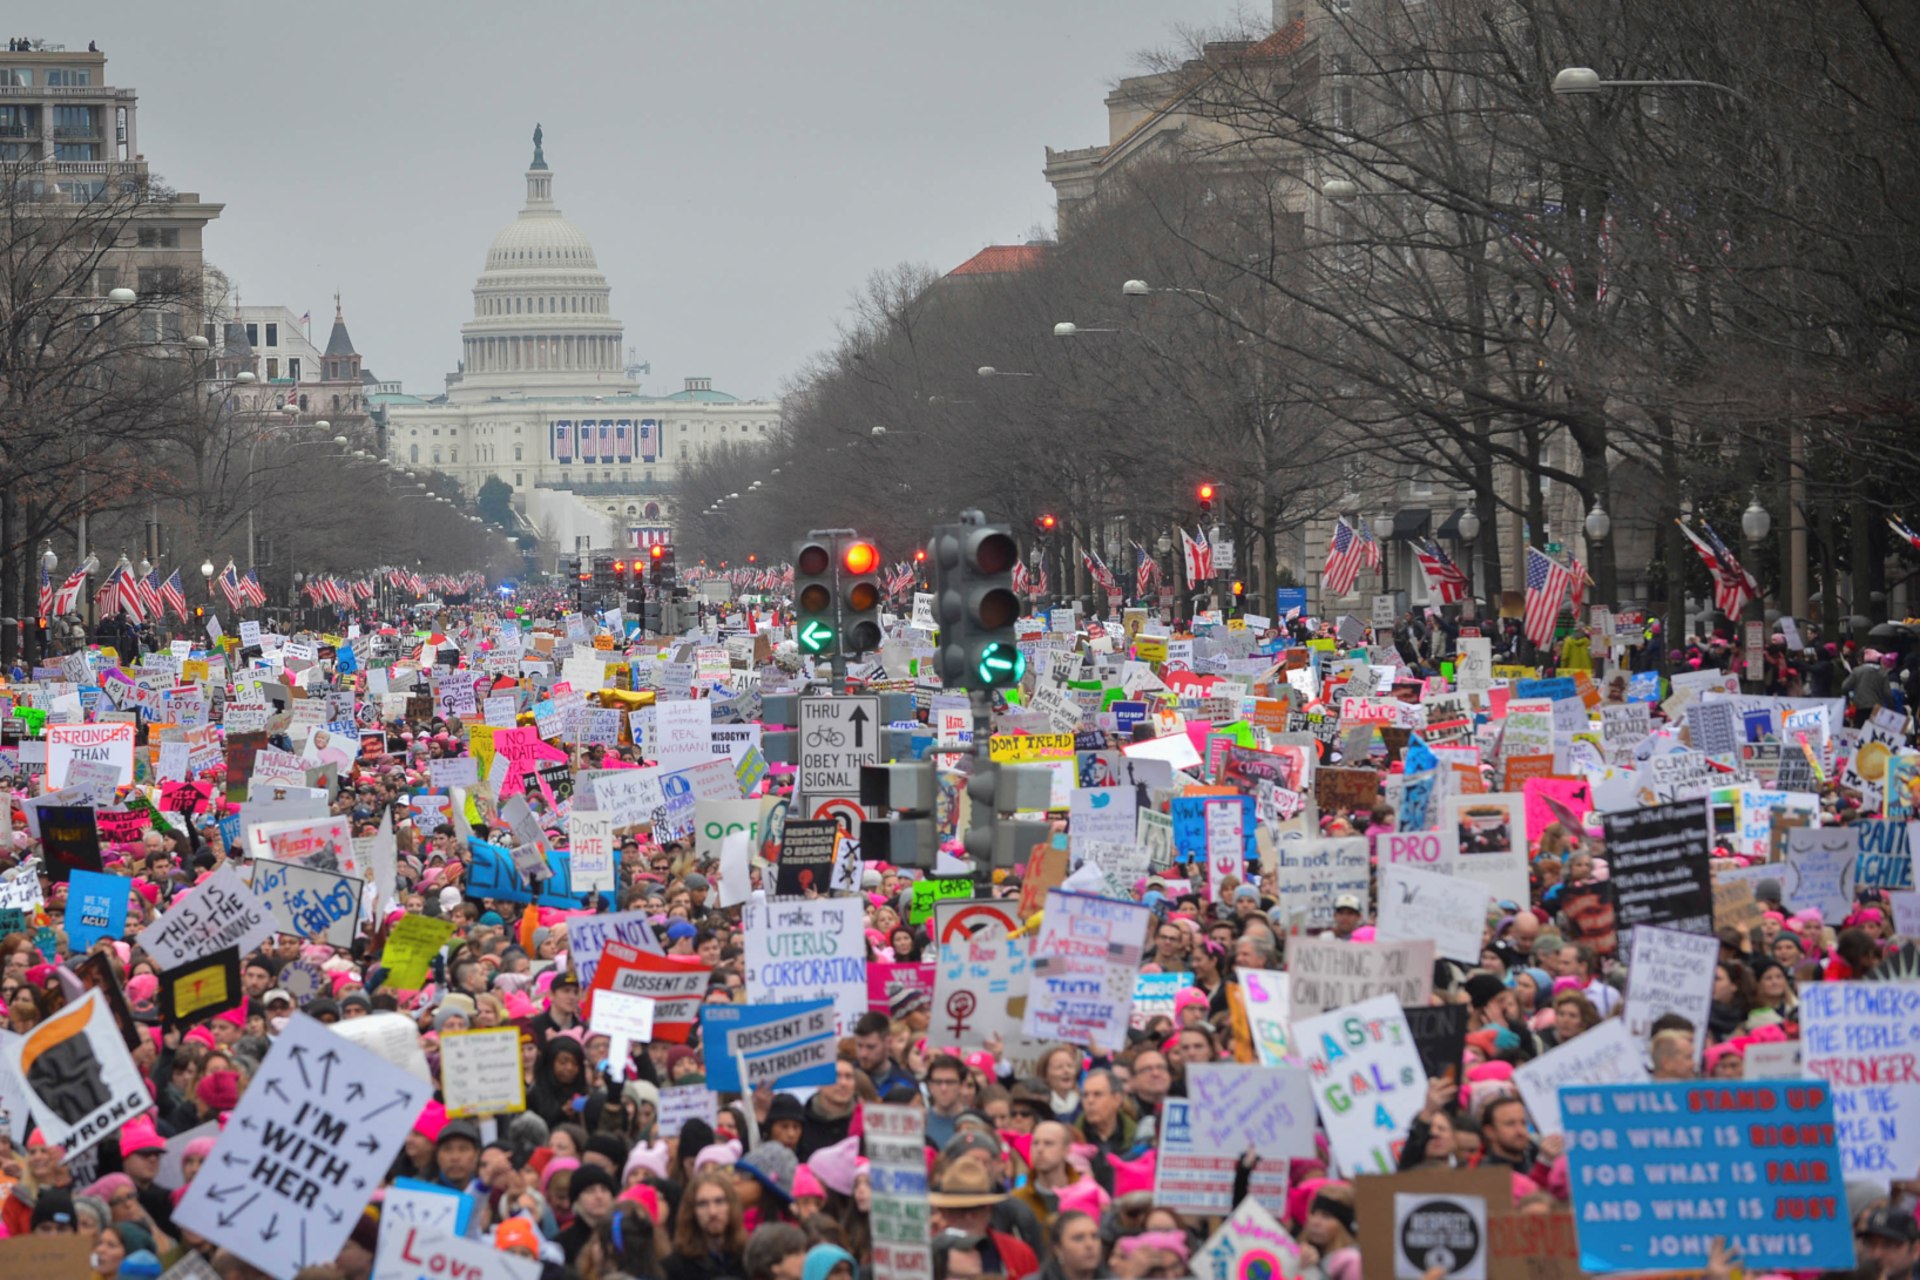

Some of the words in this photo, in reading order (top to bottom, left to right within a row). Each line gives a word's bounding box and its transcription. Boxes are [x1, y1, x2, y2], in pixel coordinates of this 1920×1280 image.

[166, 701, 201, 712] LOVE
[804, 703, 840, 719] THRU
[1344, 698, 1397, 720] future
[166, 711, 176, 724] IS
[1788, 711, 1822, 727] FUCK
[51, 728, 130, 744] STRONGER
[505, 731, 526, 746] NO
[671, 729, 699, 740] REAL
[711, 731, 750, 742] MISOGYNY
[1603, 720, 1649, 741] GREATER
[497, 744, 538, 761] ANDATE
[711, 744, 731, 754] KILLS
[1024, 734, 1072, 750] TREAD
[71, 747, 110, 761] THAN
[804, 753, 840, 769] OBEY
[846, 752, 876, 768] THIS
[1654, 753, 1705, 770] CLIMATE
[524, 769, 570, 787] FENIST
[804, 771, 853, 788] SIGNAL
[172, 798, 195, 811] UP
[785, 826, 824, 837] RESPETA
[785, 837, 834, 846] EXISTENCIA
[573, 838, 603, 855] HATE
[783, 846, 793, 855] O
[794, 846, 833, 855] ESPERA
[1389, 835, 1441, 863] PRO
[782, 855, 832, 865] RESISTENCIA
[1303, 851, 1329, 868] not
[254, 866, 288, 896] NOT
[82, 904, 110, 917] PEOPLE
[84, 895, 96, 905] WE
[97, 896, 111, 906] THE
[1080, 901, 1133, 921] MARCH
[82, 916, 109, 927] ACLU
[155, 907, 199, 948] THIS
[201, 885, 226, 911] IS
[174, 920, 210, 959] ONLY
[208, 893, 244, 928] THE
[778, 906, 814, 927] make
[822, 909, 845, 935] my
[196, 910, 261, 957] EGINNING
[613, 919, 650, 946] NOT
[766, 930, 838, 957] UTERUS
[748, 968, 756, 981] a
[761, 956, 866, 988] CORPORATION
[1294, 952, 1374, 977] ANYTHING
[1378, 950, 1411, 976] YOU
[623, 973, 682, 992] DISSENT
[684, 975, 699, 990] IS
[1046, 979, 1101, 993] TRUTH
[1802, 984, 1839, 1018] THE
[1843, 986, 1905, 1018] POWER
[736, 1019, 802, 1049] DISSENT
[808, 1013, 824, 1031] IS
[1806, 1022, 1839, 1054] THE
[1844, 1023, 1907, 1051] PEOPLE
[1309, 1017, 1404, 1081] NASTY
[749, 1043, 827, 1078] PATRIOTIC
[1806, 1052, 1920, 1088] STRONGER
[1324, 1063, 1415, 1114] GALS
[1563, 1092, 1604, 1116] WE
[1612, 1091, 1679, 1114] WILL
[1686, 1087, 1778, 1113] STAND
[1785, 1086, 1826, 1111] UP
[1861, 1087, 1899, 1113] THE
[64, 1092, 144, 1150] WRONG
[294, 1101, 349, 1147] I'M
[1878, 1116, 1897, 1142] IN
[1564, 1128, 1618, 1151] FOR
[1626, 1126, 1704, 1149] WHAT
[1714, 1125, 1741, 1147] IS
[1749, 1122, 1836, 1148] RIGHT
[261, 1118, 351, 1187] WITH
[1842, 1142, 1898, 1172] OWER
[251, 1155, 322, 1211] HER
[1581, 1164, 1635, 1187] FOR
[1643, 1162, 1721, 1184] WHAT
[1731, 1161, 1757, 1183] IS
[1765, 1160, 1830, 1183] FAIR
[1582, 1200, 1642, 1222] AND
[1650, 1198, 1729, 1221] WHAT
[1737, 1197, 1764, 1219] IS
[1773, 1196, 1838, 1221] JUST
[401, 1227, 483, 1280] Love
